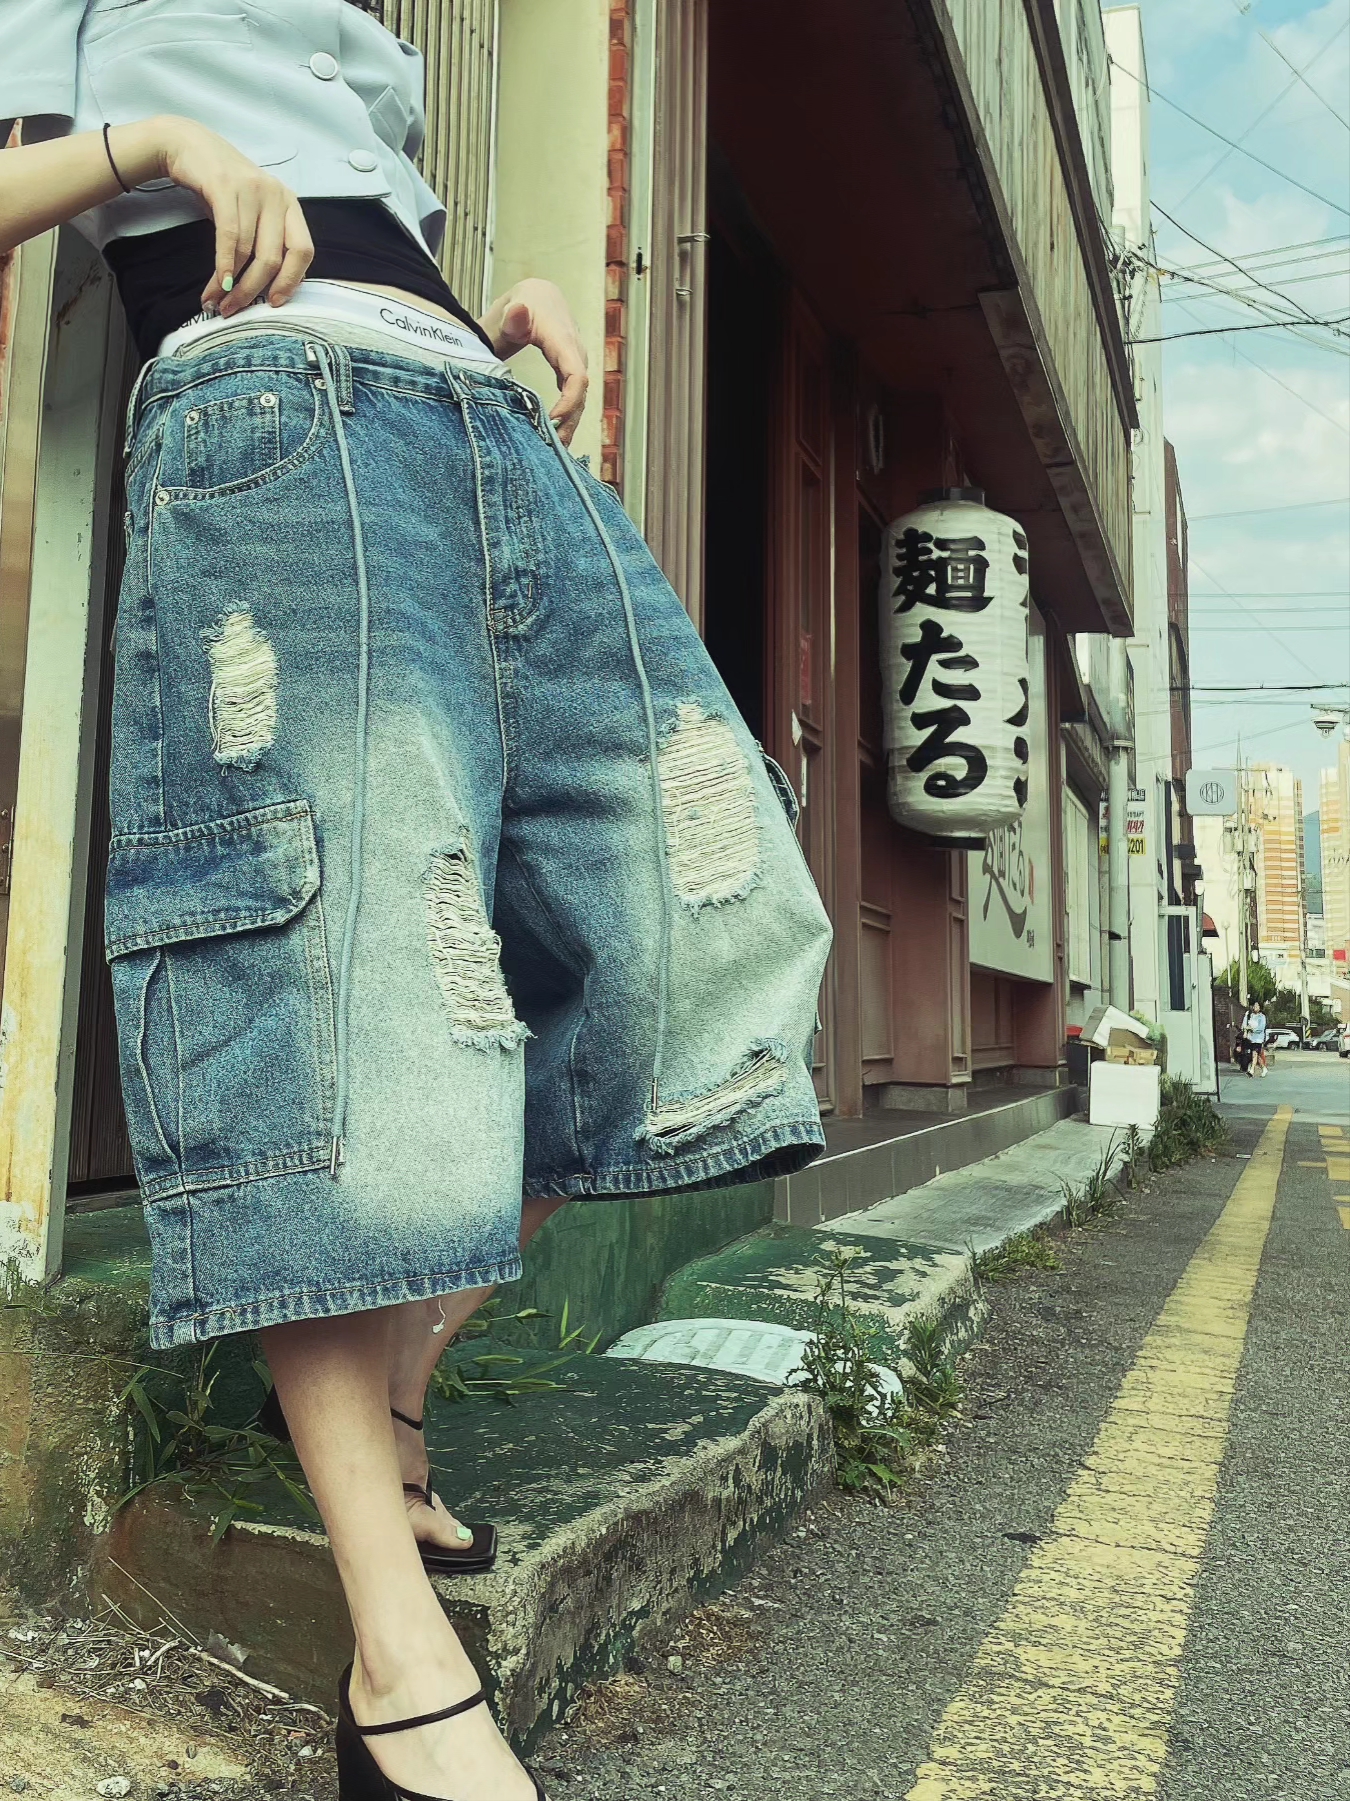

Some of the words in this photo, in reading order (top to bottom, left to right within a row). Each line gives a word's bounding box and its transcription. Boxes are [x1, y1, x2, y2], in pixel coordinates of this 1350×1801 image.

[380, 308, 464, 348] CalvinKlein
[892, 527, 994, 800] 麺たる
